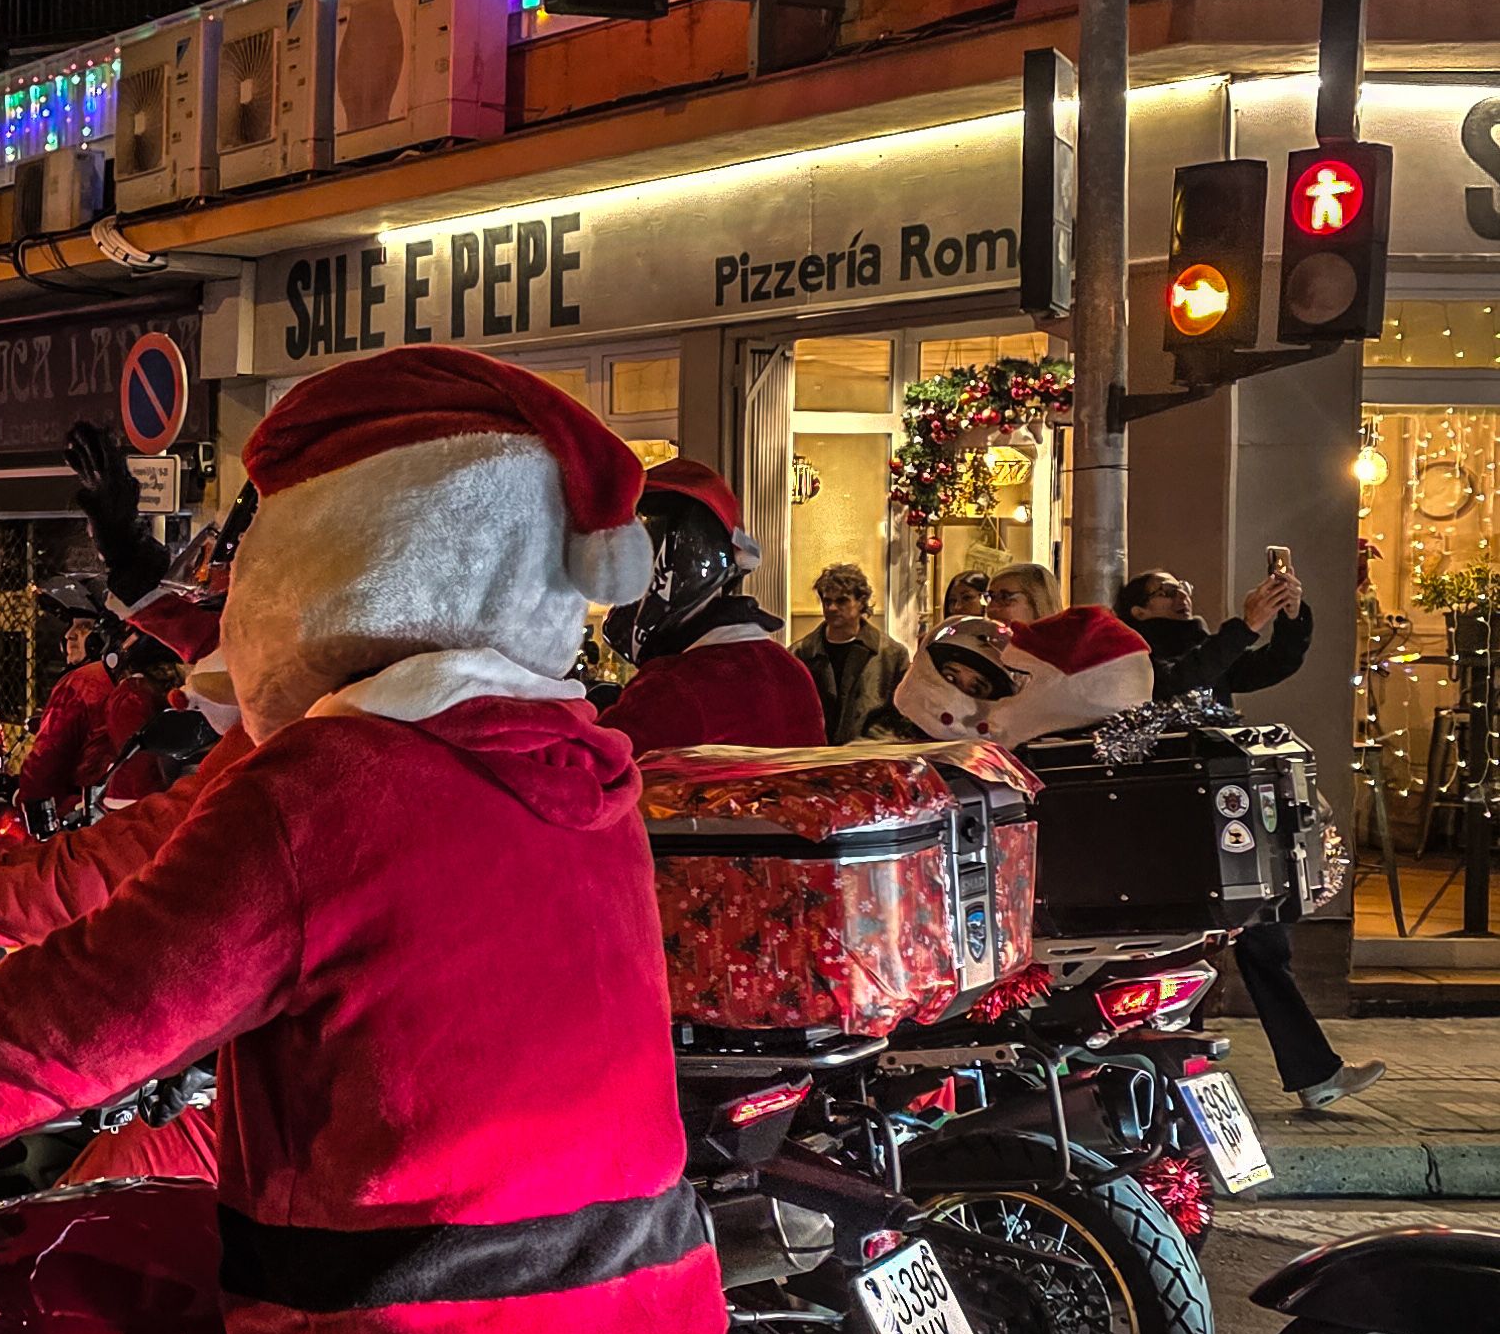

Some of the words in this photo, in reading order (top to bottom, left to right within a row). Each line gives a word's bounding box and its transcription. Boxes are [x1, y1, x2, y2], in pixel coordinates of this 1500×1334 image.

[285, 245, 388, 360] SALE
[404, 239, 433, 345] E
[451, 211, 581, 340] PEPE
[714, 227, 883, 307] Pizzería
[899, 222, 1021, 282] Rom
